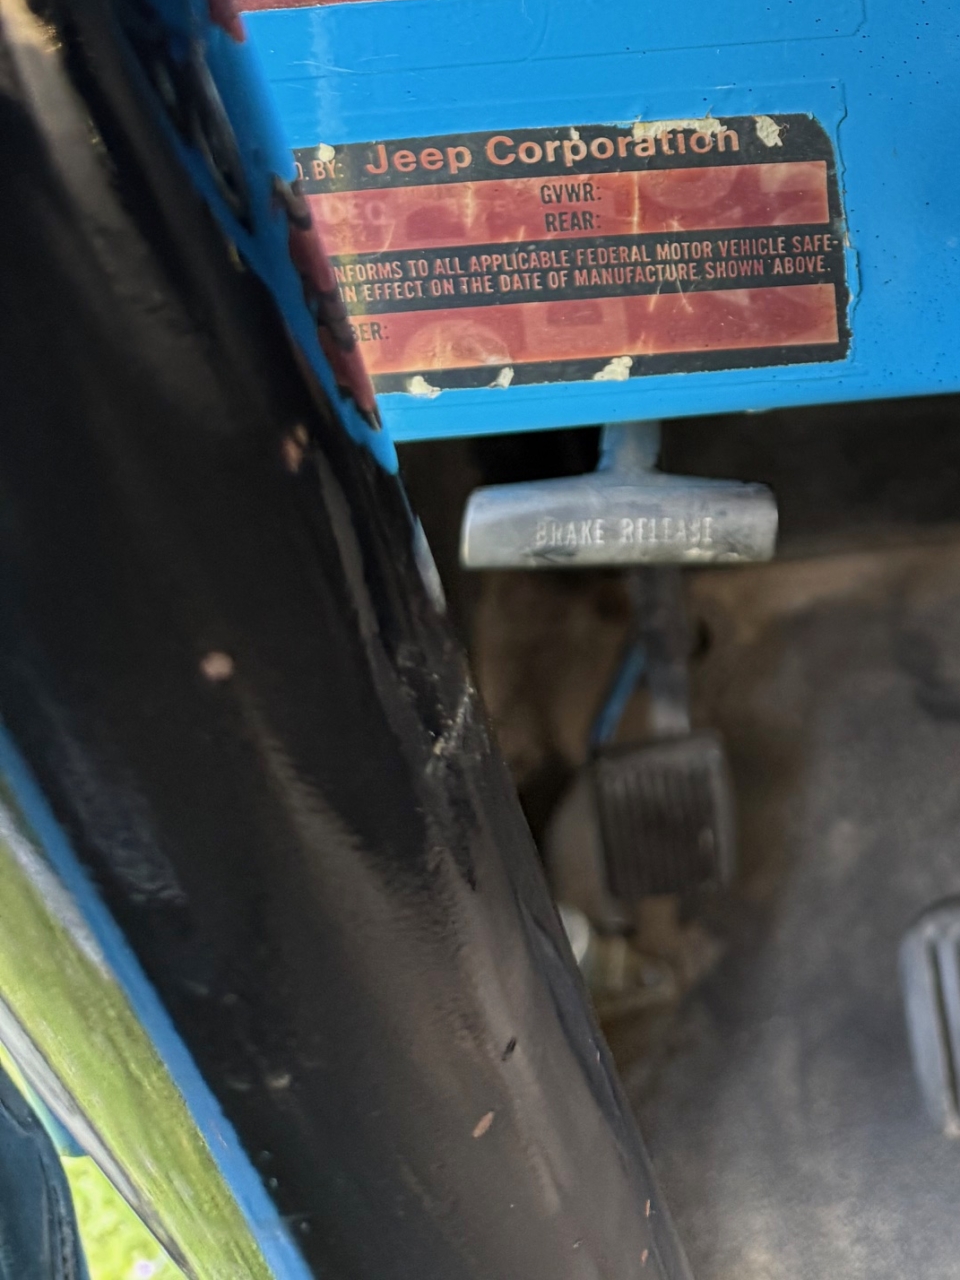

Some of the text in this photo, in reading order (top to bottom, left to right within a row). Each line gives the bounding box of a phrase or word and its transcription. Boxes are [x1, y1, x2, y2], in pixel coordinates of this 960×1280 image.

[365, 144, 473, 174] Jeep
[486, 128, 740, 167] Corporation
[540, 181, 602, 205] GVWR:
[545, 210, 602, 232] REAR:
[408, 259, 429, 277] TO
[434, 256, 464, 275] ALL
[469, 250, 570, 273] APPLICABLE
[576, 245, 652, 265] FEDERAL
[656, 240, 713, 261] MOTOR
[718, 237, 786, 257] VEHICLE
[792, 234, 839, 253] SAFE-
[363, 281, 424, 301] EFFECT
[431, 278, 455, 297] ON
[462, 275, 494, 295] THE
[501, 272, 543, 292] DATE
[549, 271, 568, 290] OF
[575, 261, 698, 287] MANUFACTURE
[705, 260, 764, 279] SHOWN
[773, 257, 831, 275] ABOVE.
[535, 519, 606, 547] BRAKE
